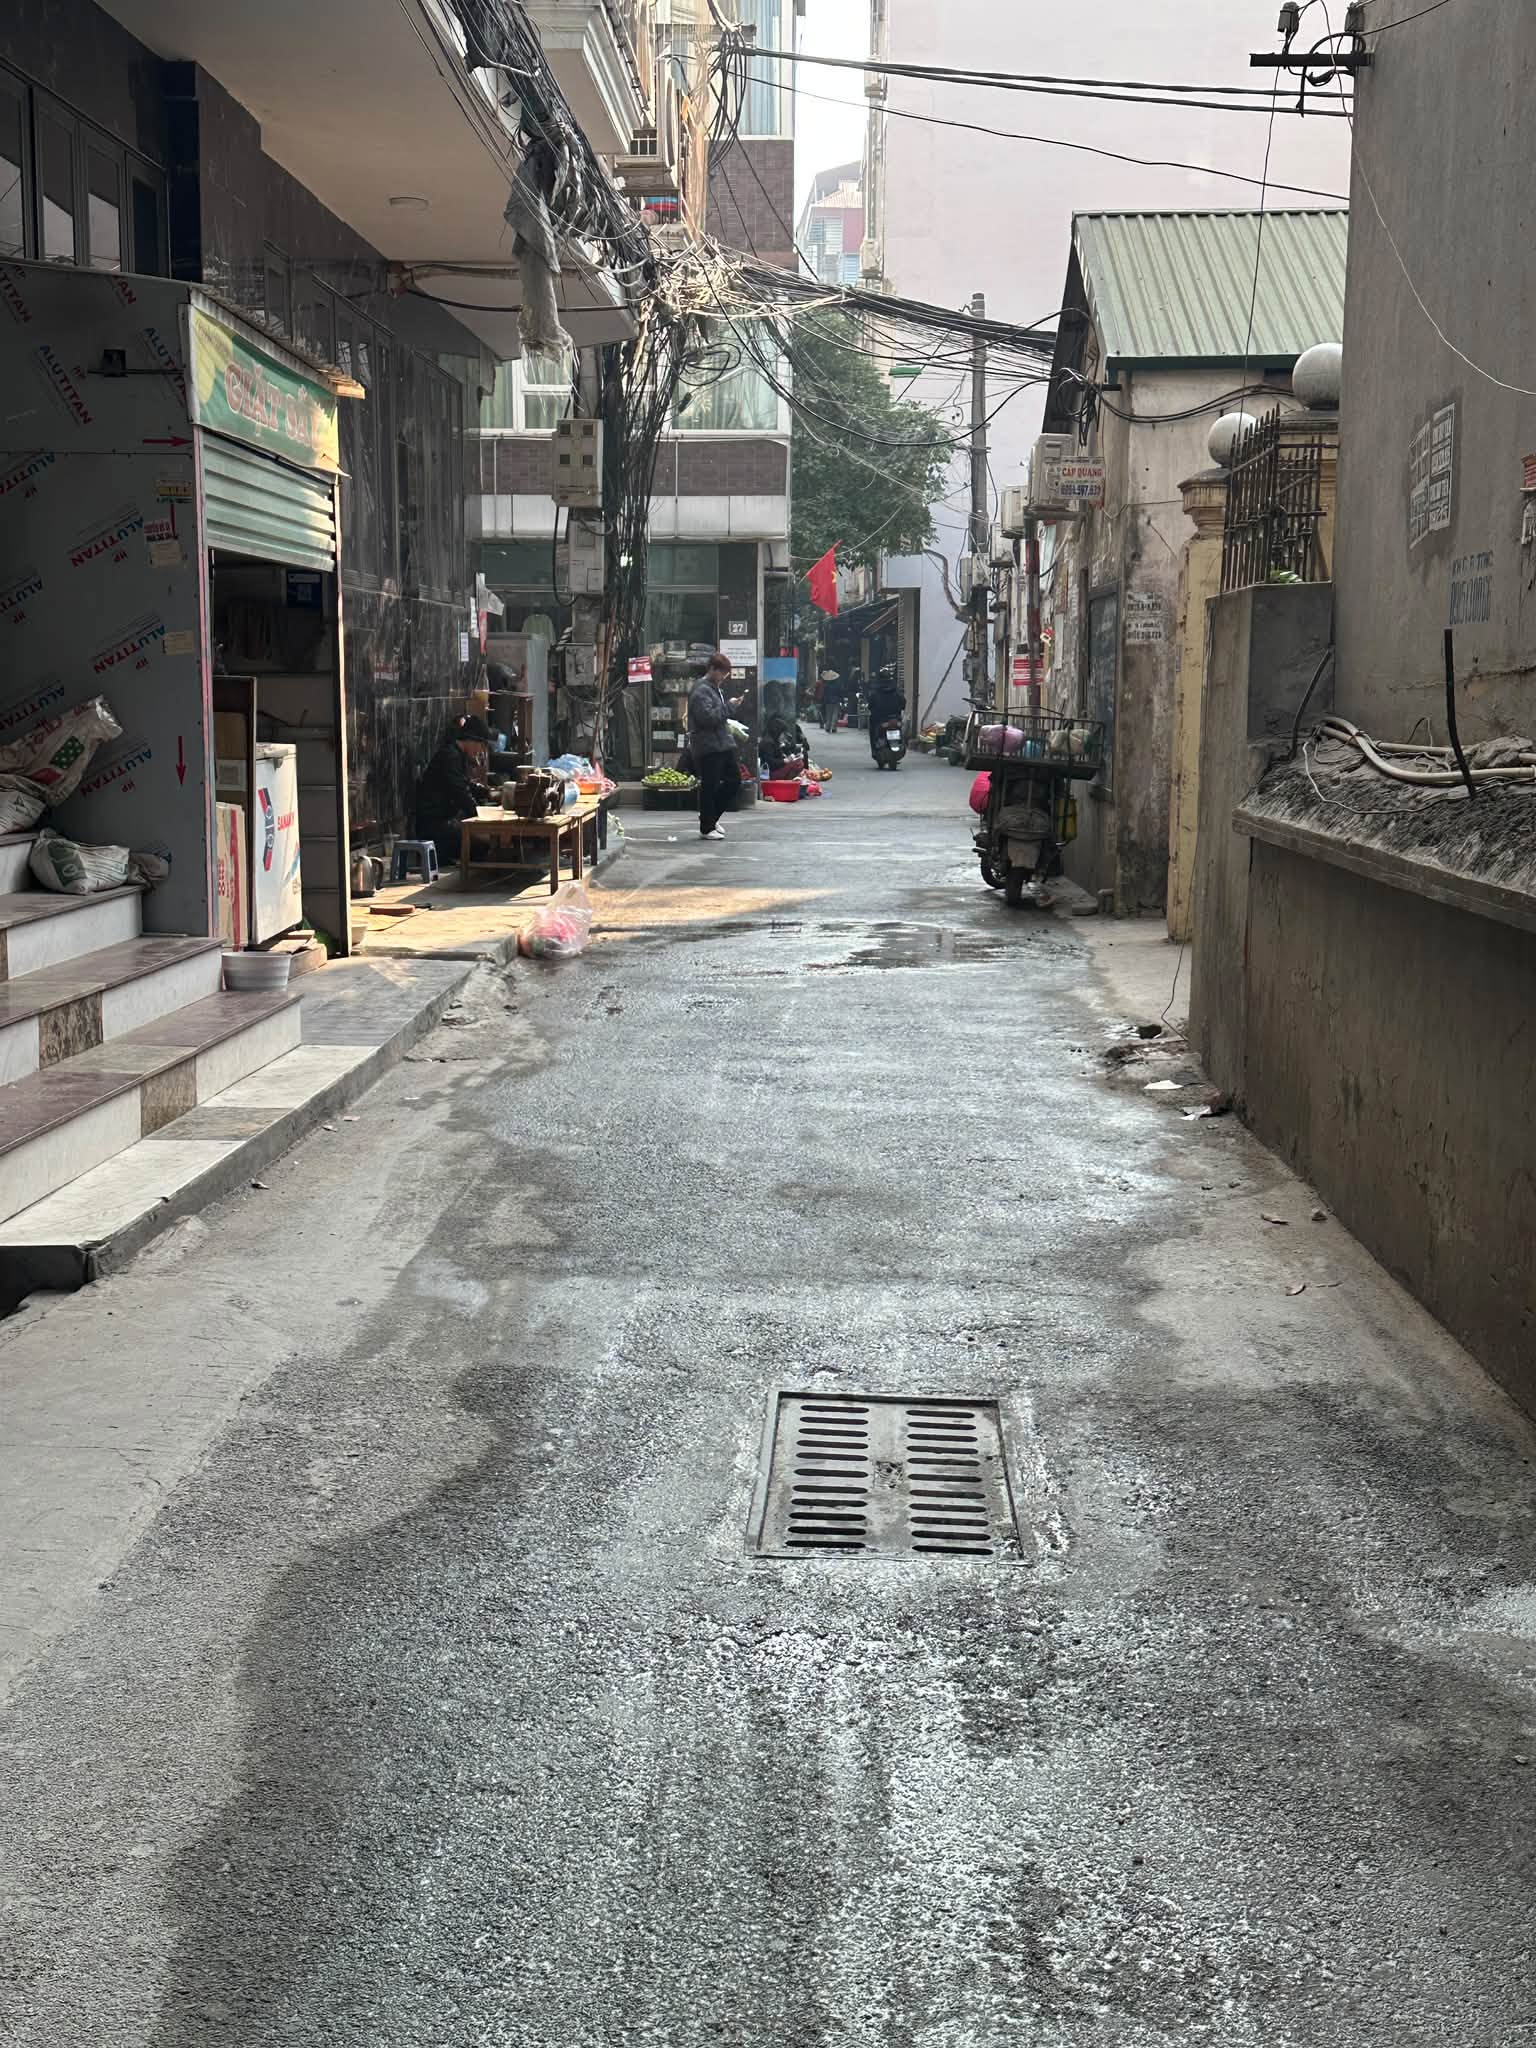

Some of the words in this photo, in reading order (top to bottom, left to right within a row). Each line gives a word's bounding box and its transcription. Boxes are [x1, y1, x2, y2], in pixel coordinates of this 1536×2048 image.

[40, 345, 94, 425] ALUTITAN
[71, 516, 144, 568] ALUTITAN
[94, 625, 166, 673] ALUTITAN
[732, 623, 744, 633] 27
[80, 749, 153, 797] ALUTITAN
